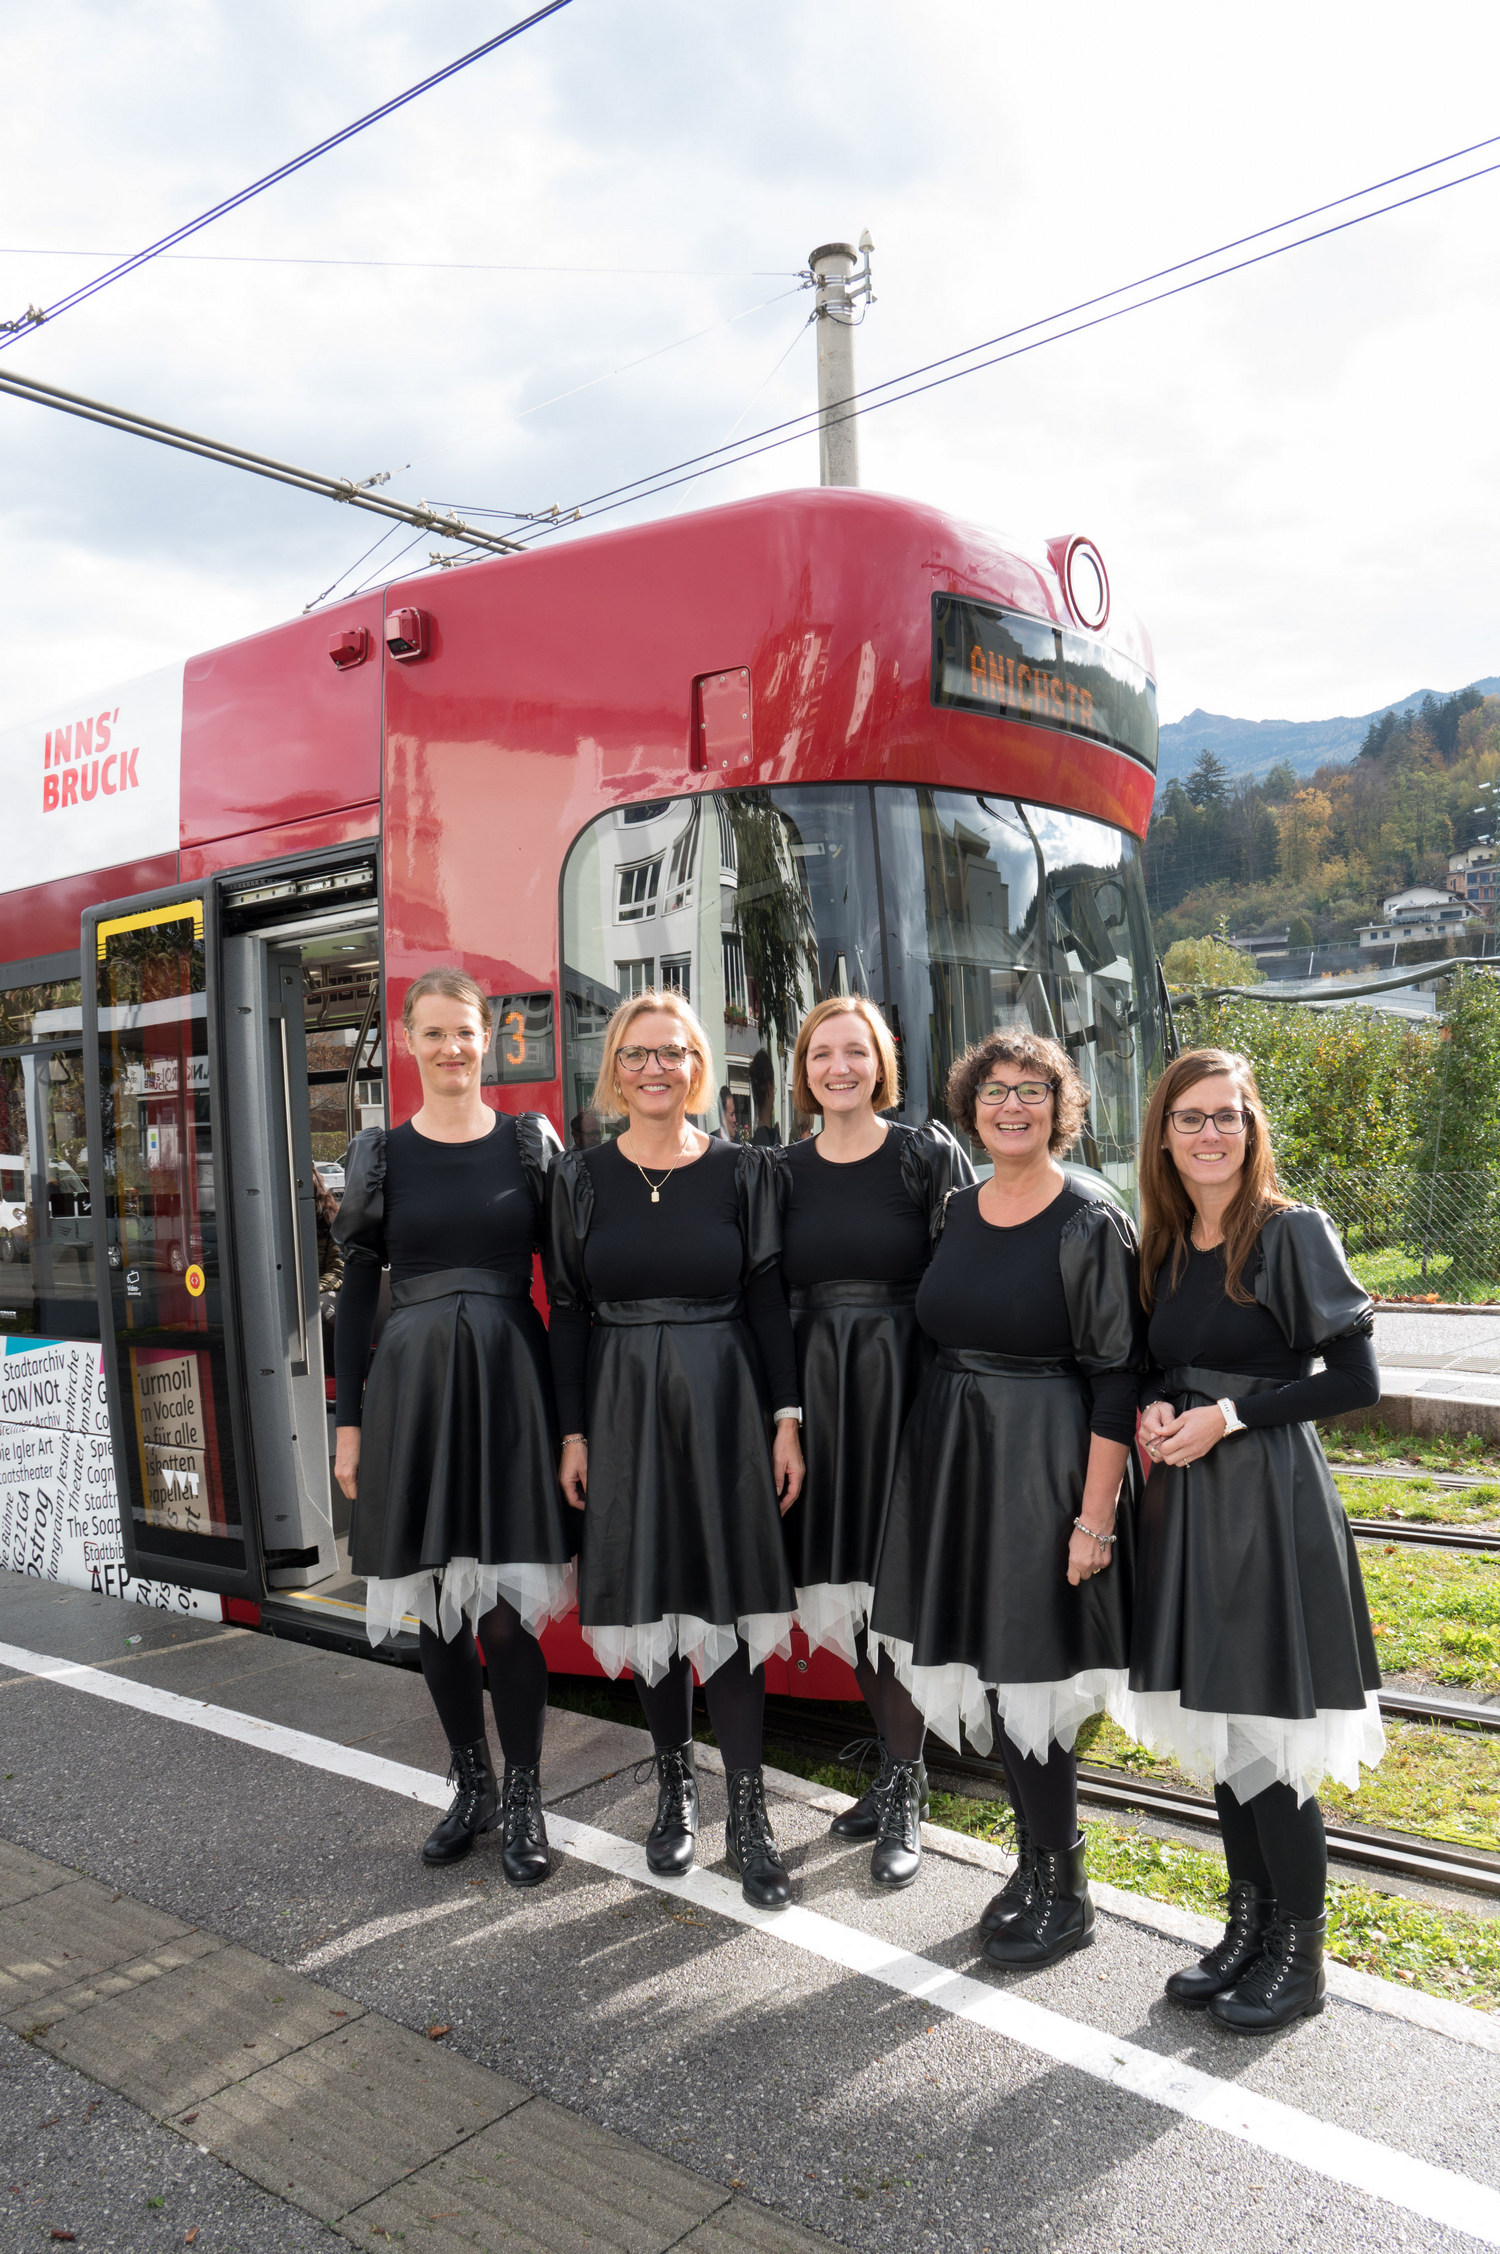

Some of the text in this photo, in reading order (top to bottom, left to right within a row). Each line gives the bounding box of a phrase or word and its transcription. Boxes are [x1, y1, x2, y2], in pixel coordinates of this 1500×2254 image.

[43, 747, 140, 813] BRUCK
[506, 1012, 525, 1065] 3
[3, 1349, 65, 1381] Stadtarchiv
[138, 1360, 192, 1396] urmoil
[153, 1394, 195, 1420] Vocale
[13, 1439, 35, 1465] Igler
[38, 1437, 54, 1456] Art
[90, 1439, 113, 1463] Spie
[174, 1422, 198, 1446] alle
[69, 1440, 84, 1513] Theater
[87, 1455, 196, 1488] Cogn iskotten
[47, 1489, 65, 1581] langraum
[67, 1516, 89, 1538] The
[84, 1541, 125, 1562] Stadtbib
